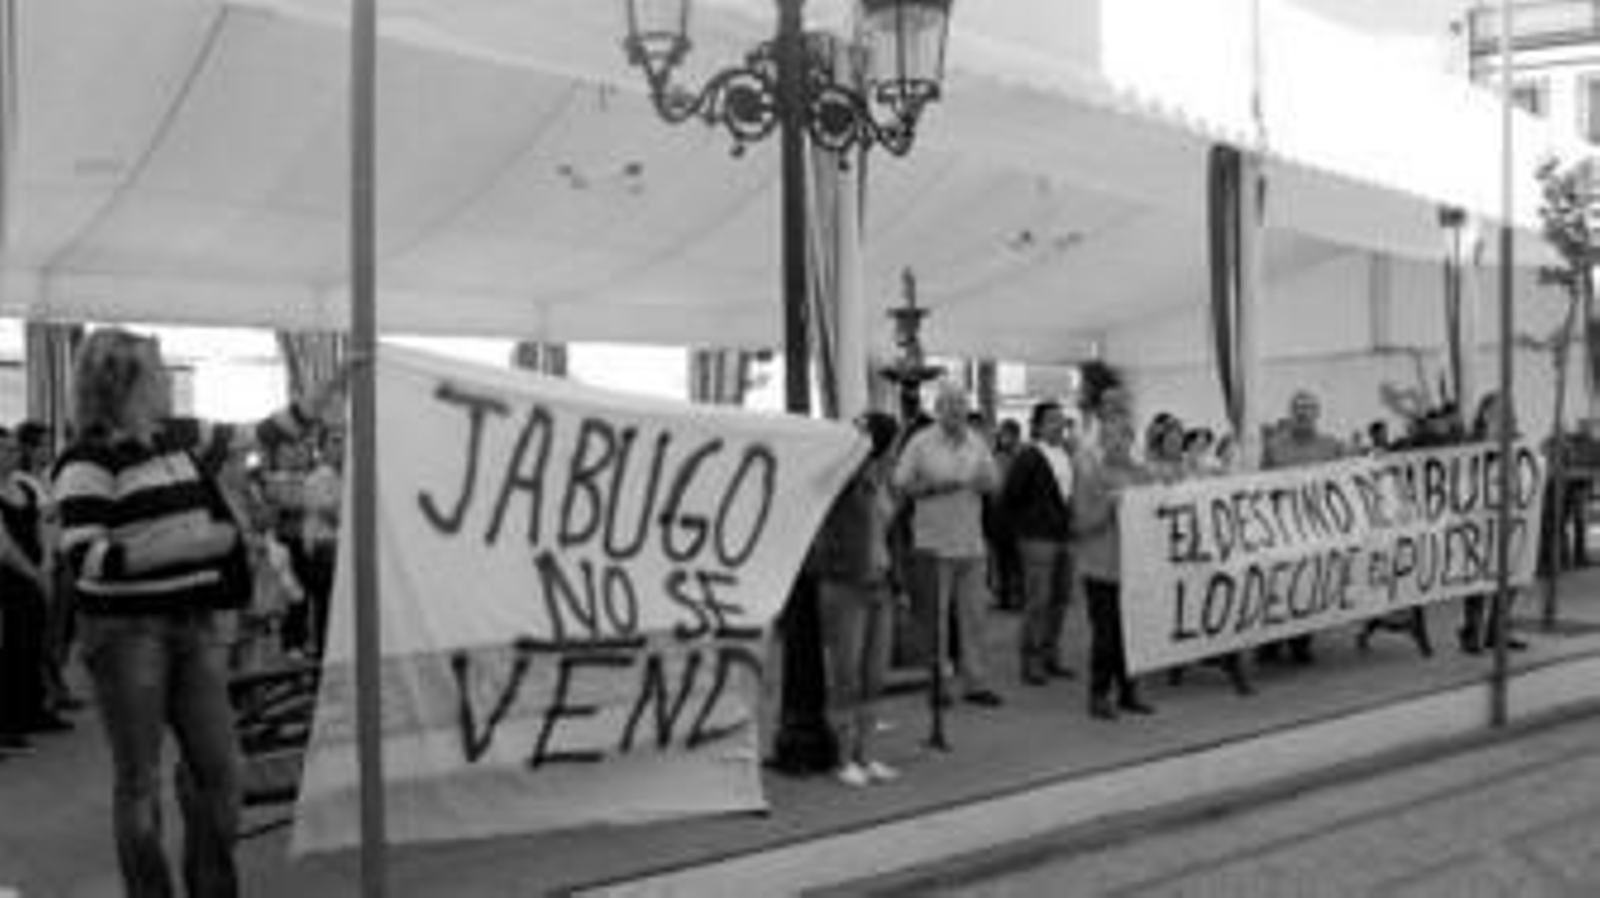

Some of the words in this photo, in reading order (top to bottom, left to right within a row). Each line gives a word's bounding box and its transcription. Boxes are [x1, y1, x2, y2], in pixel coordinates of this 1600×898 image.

[418, 384, 777, 568] JABUGO
[1157, 502, 1212, 563] EL
[1210, 482, 1354, 562] DESTINO
[534, 550, 641, 648] NO
[664, 569, 763, 642] SE
[1171, 572, 1237, 645] LO
